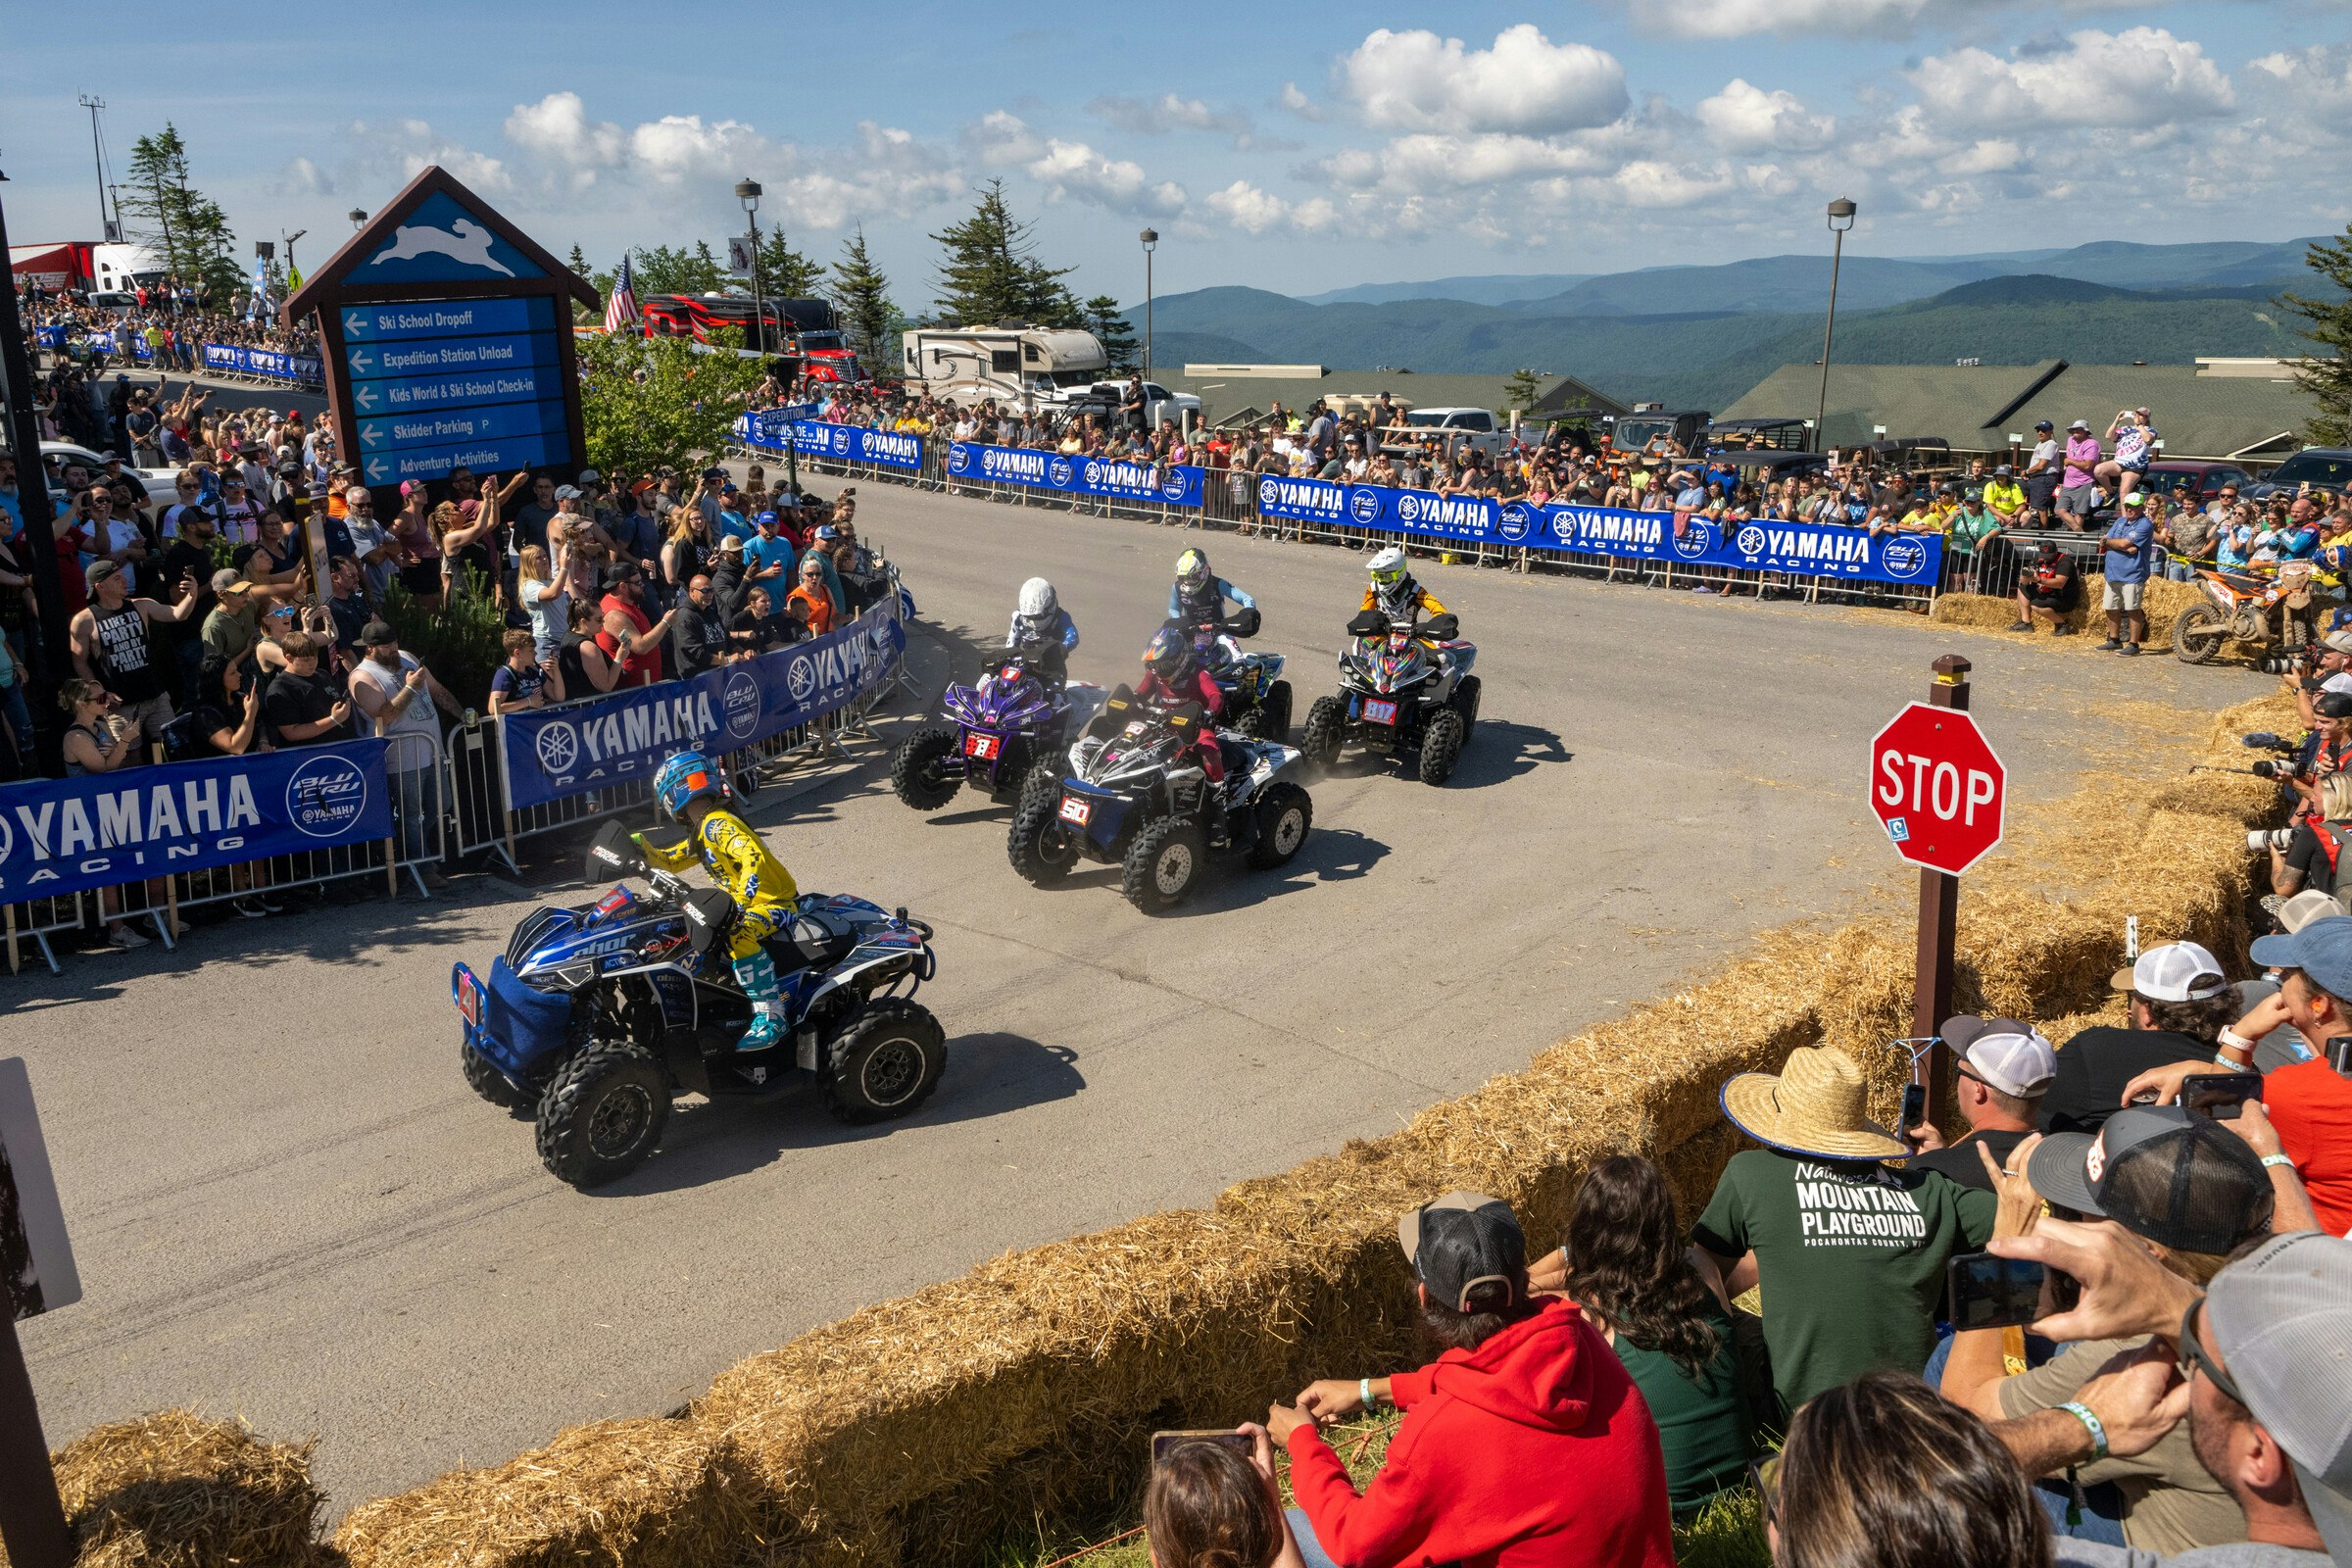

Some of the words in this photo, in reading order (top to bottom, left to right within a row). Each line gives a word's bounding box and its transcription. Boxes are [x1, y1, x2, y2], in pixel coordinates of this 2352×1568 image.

[378, 315, 396, 329] Ski
[399, 313, 433, 328] School
[436, 311, 472, 328] Dropoff
[383, 351, 439, 369] Expedition
[441, 348, 476, 364] Station
[478, 345, 513, 361] Unload
[389, 387, 411, 403] Kids
[413, 385, 438, 401] World
[440, 385, 448, 398] &
[450, 383, 464, 398] Ski
[466, 381, 495, 397] School
[497, 378, 534, 393] Check-in
[762, 407, 807, 424] EXPEDITION
[394, 424, 433, 440] Skidder
[435, 420, 473, 437] Parking
[781, 441, 827, 452] RCING
[874, 435, 918, 458] YAMAHA
[400, 455, 451, 473] Adventure
[453, 450, 499, 468] Activities
[865, 453, 914, 465] RACING
[996, 452, 1045, 475] YAMAHA
[986, 470, 1041, 482] RACING
[1090, 484, 1152, 496] RACING
[1279, 483, 1343, 511] YAMAHA
[1265, 505, 1338, 518] RACING
[1420, 498, 1489, 527] YAMAHA
[1404, 521, 1484, 536] RACING
[1578, 513, 1662, 544] YAMAHA
[1561, 539, 1655, 553] RACING
[1768, 530, 1869, 564] YAMAHA
[1745, 557, 1861, 572] RACING
[97, 621, 104, 632] I
[102, 614, 126, 630] LIKE
[124, 611, 140, 623] TO
[100, 620, 144, 646] PARTY
[114, 641, 130, 653] AND
[129, 637, 141, 648] BY
[110, 645, 147, 667] PARTY
[119, 664, 123, 673] I
[726, 685, 753, 701] BLU
[799, 670, 873, 712] RACING
[1366, 701, 1396, 720] 817
[583, 691, 719, 762] YAMAHA
[973, 739, 991, 757] 1
[293, 772, 355, 789] BLU
[1879, 749, 1995, 826] STOP
[16, 774, 261, 861] YAMAHA
[1061, 798, 1089, 821] 510
[0, 836, 245, 889] ACING
[596, 845, 619, 860] MOOSE
[596, 851, 622, 866] RACING
[685, 901, 706, 919] MOOSE
[685, 906, 707, 926] RACING
[1794, 1162, 1864, 1185] Nature's
[1796, 1182, 1921, 1213] MOUNTAIN
[1801, 1212, 1927, 1238] PLAYGROUND
[1804, 1238, 1868, 1247] POCAHONTAS
[1872, 1239, 1909, 1249] COUNTY,
